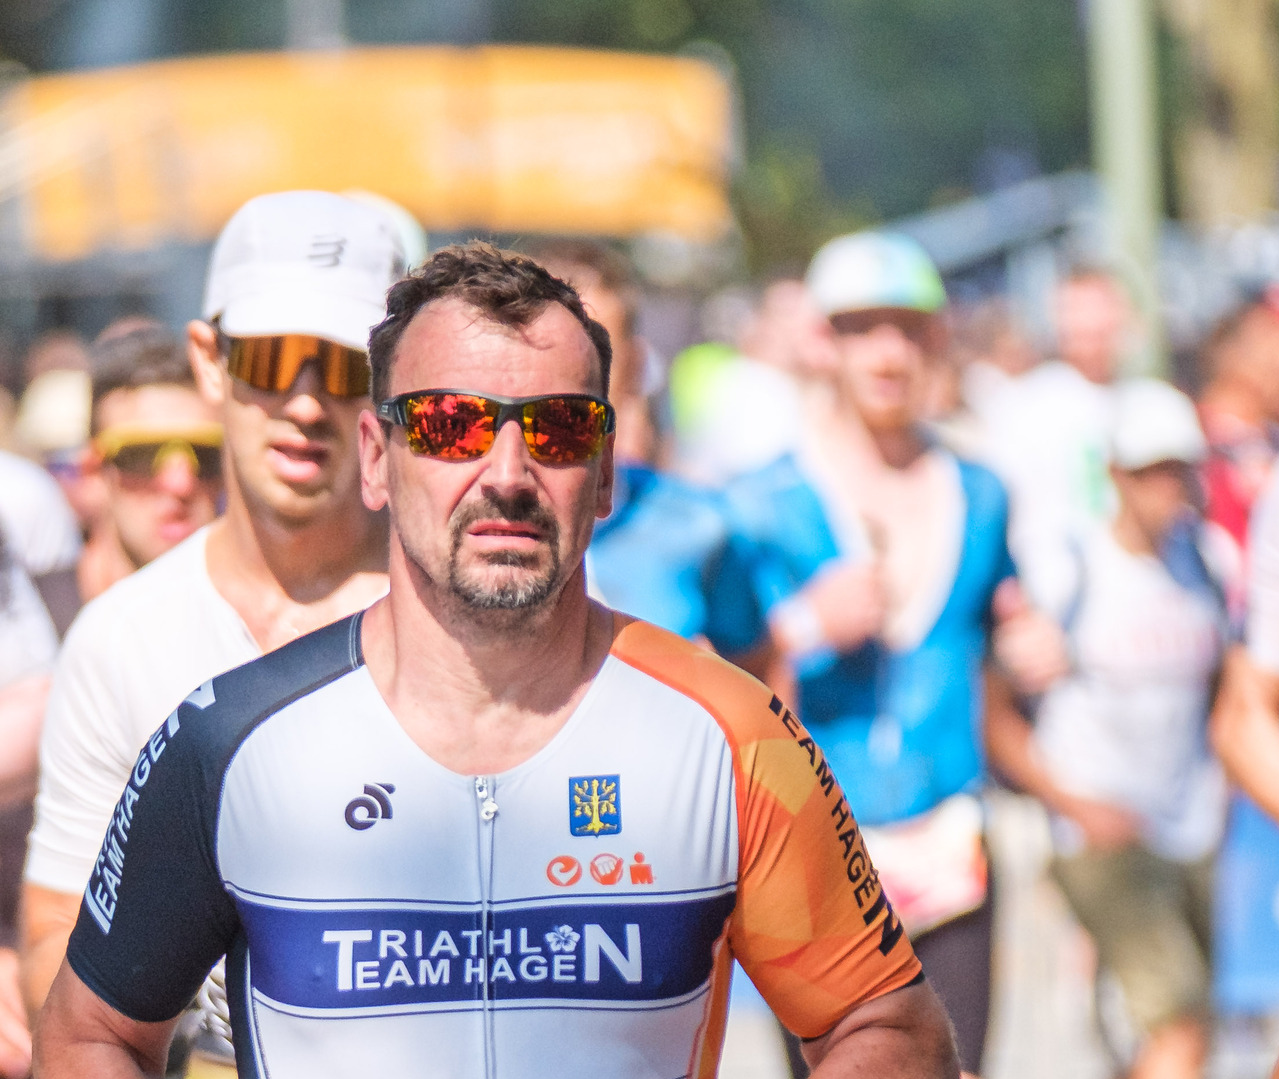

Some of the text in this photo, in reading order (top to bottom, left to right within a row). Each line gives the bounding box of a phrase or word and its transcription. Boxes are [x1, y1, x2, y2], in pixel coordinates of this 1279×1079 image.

[769, 694, 836, 797] EAM
[322, 923, 643, 991] TEAM HAGEN
